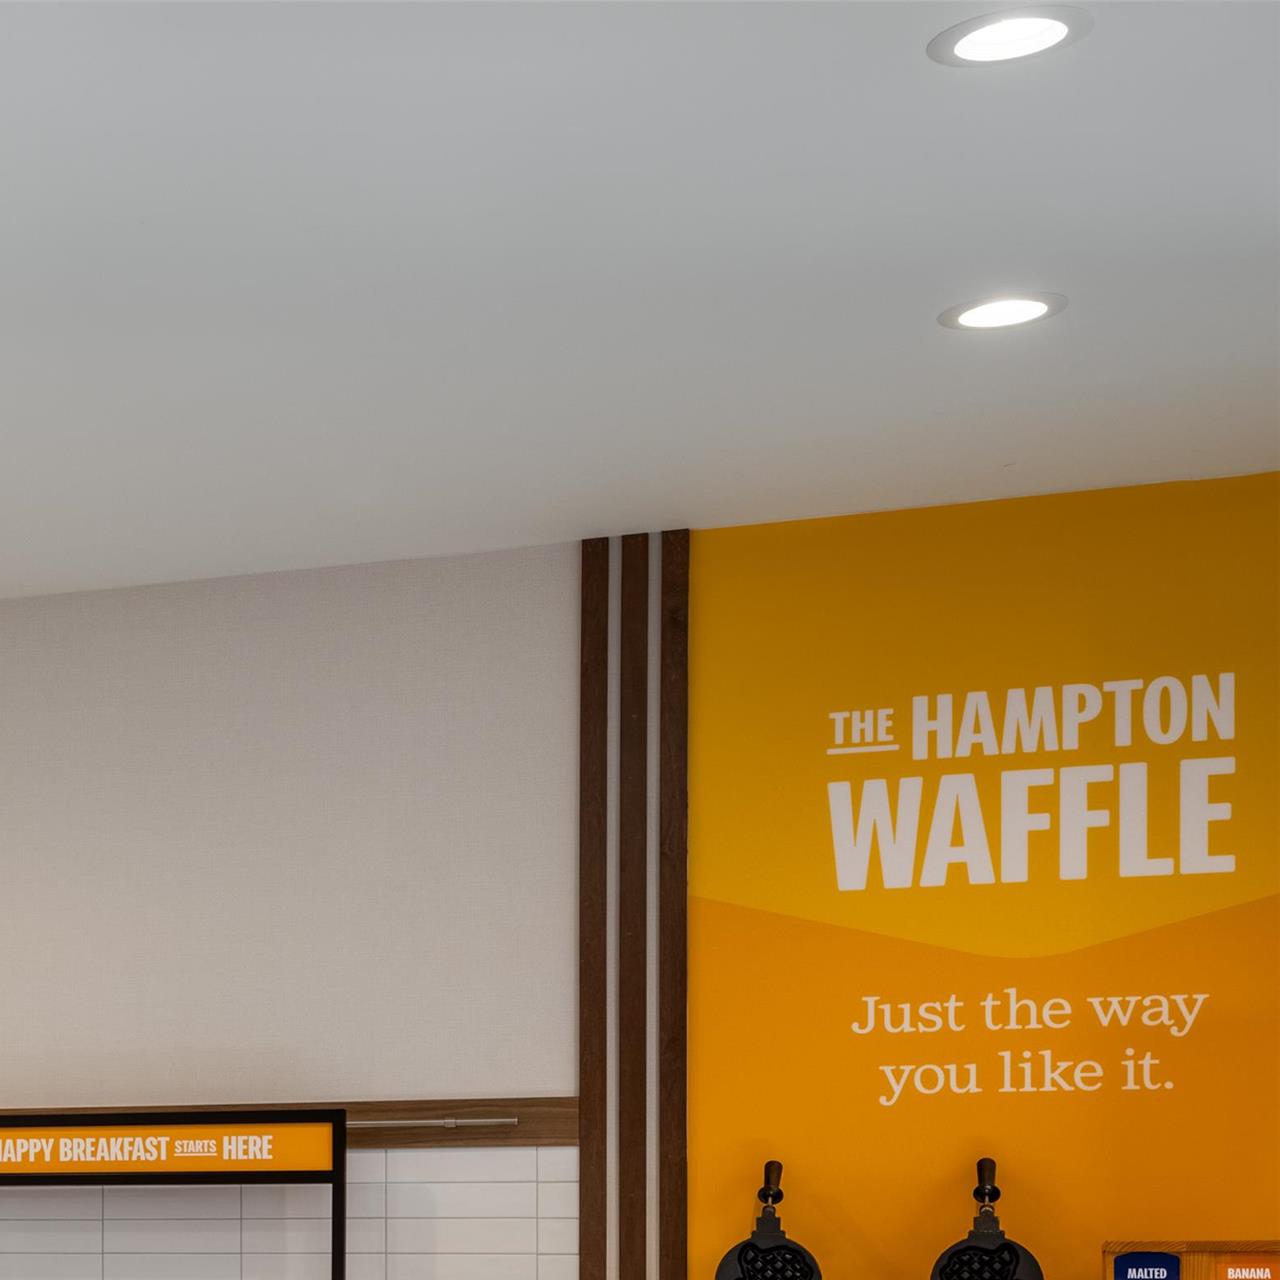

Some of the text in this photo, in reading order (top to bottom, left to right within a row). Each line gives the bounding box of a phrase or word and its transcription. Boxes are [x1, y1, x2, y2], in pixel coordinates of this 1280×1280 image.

[828, 671, 1236, 761] THE HAMPTON
[827, 756, 1236, 892] WAFFLE
[851, 987, 1210, 1037] Just the way
[878, 1047, 1175, 1107] you like it.
[59, 1136, 170, 1162] BREAKFAST
[174, 1140, 217, 1153] STARTS
[222, 1135, 273, 1160] HERE
[1127, 1267, 1167, 1279] MALTED
[1227, 1267, 1271, 1279] BANANA
